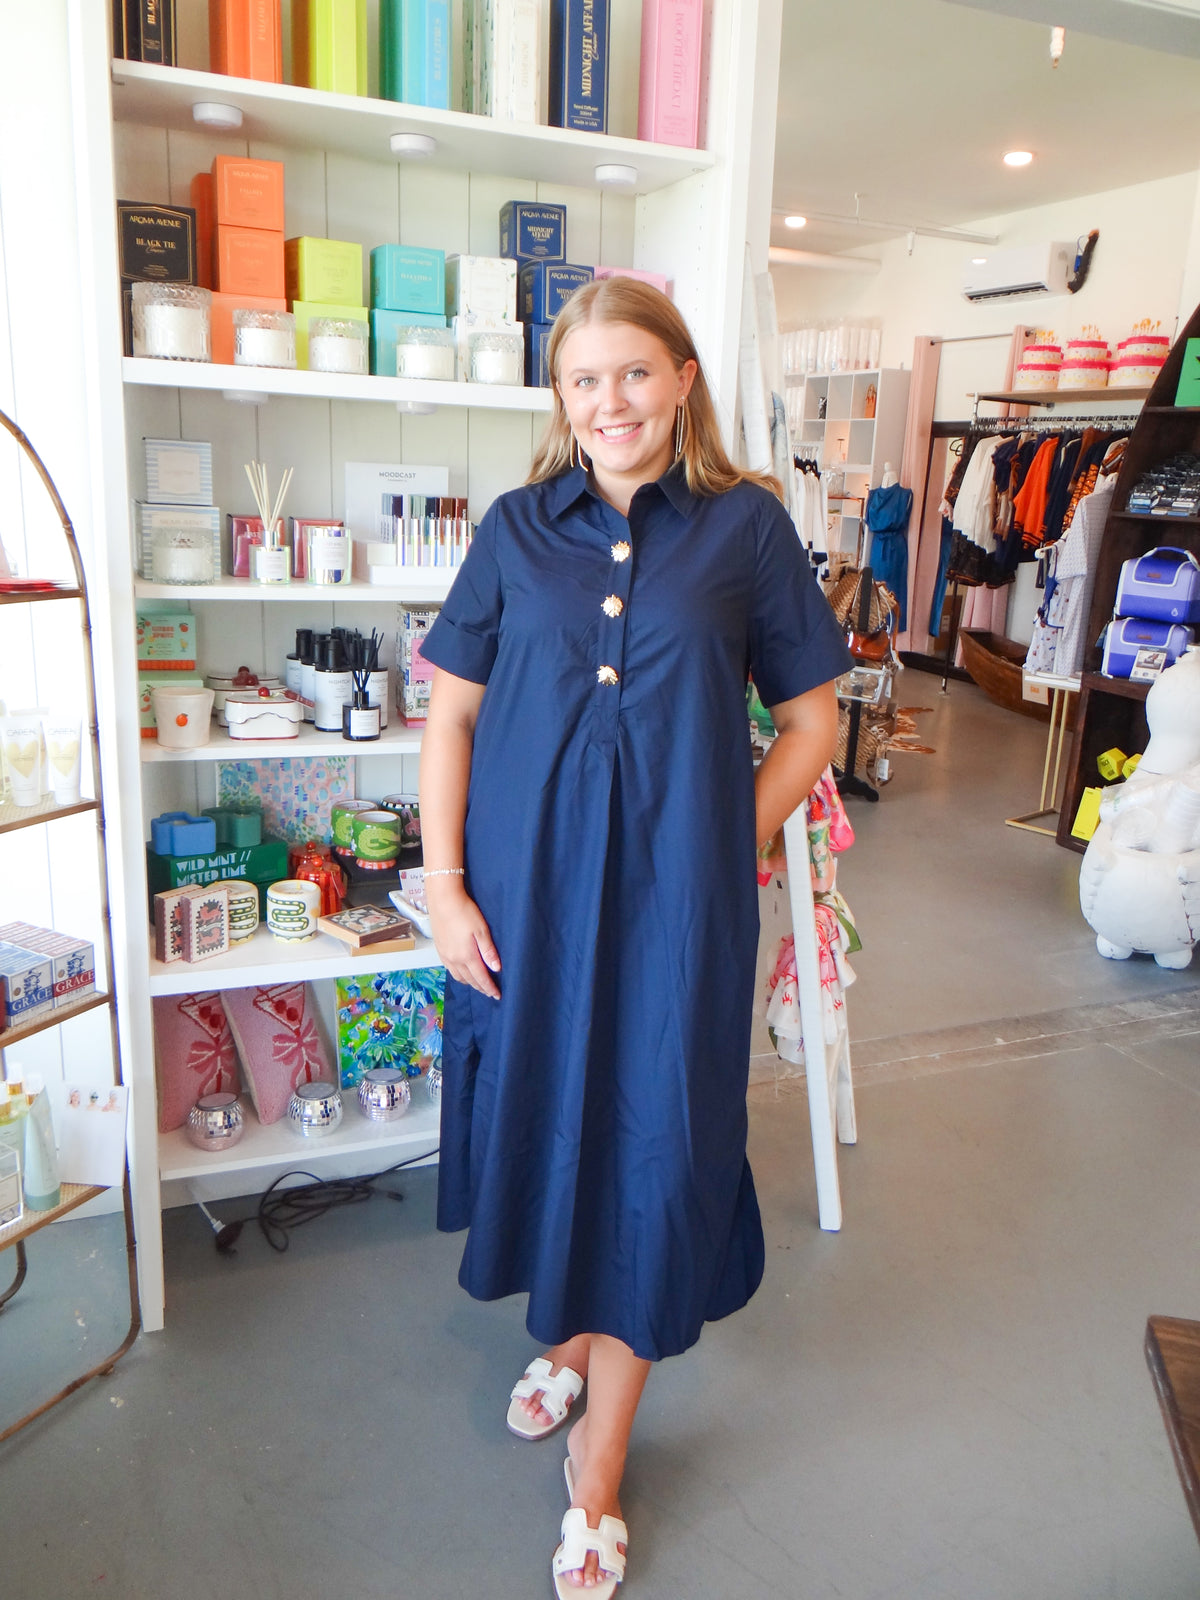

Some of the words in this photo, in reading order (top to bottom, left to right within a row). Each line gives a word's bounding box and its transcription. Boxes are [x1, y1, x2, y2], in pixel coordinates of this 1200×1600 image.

[673, 12, 685, 57] BLOOM
[581, 35, 593, 97] MIDNIGHT
[129, 215, 154, 225] AROMA
[156, 218, 181, 228] AVENUE
[522, 210, 540, 218] AROMA
[541, 212, 559, 220] AVENUE
[136, 237, 161, 248] BLACK
[163, 240, 176, 249] TIE
[551, 272, 569, 280] AROMA
[379, 471, 417, 479] MOODCAST
[176, 858, 205, 873] WILD
[208, 852, 237, 868] MINT
[176, 869, 219, 887] MISTED
[221, 864, 247, 879] LIME
[55, 970, 94, 993] GRACE
[12, 989, 52, 1011] GRACE
